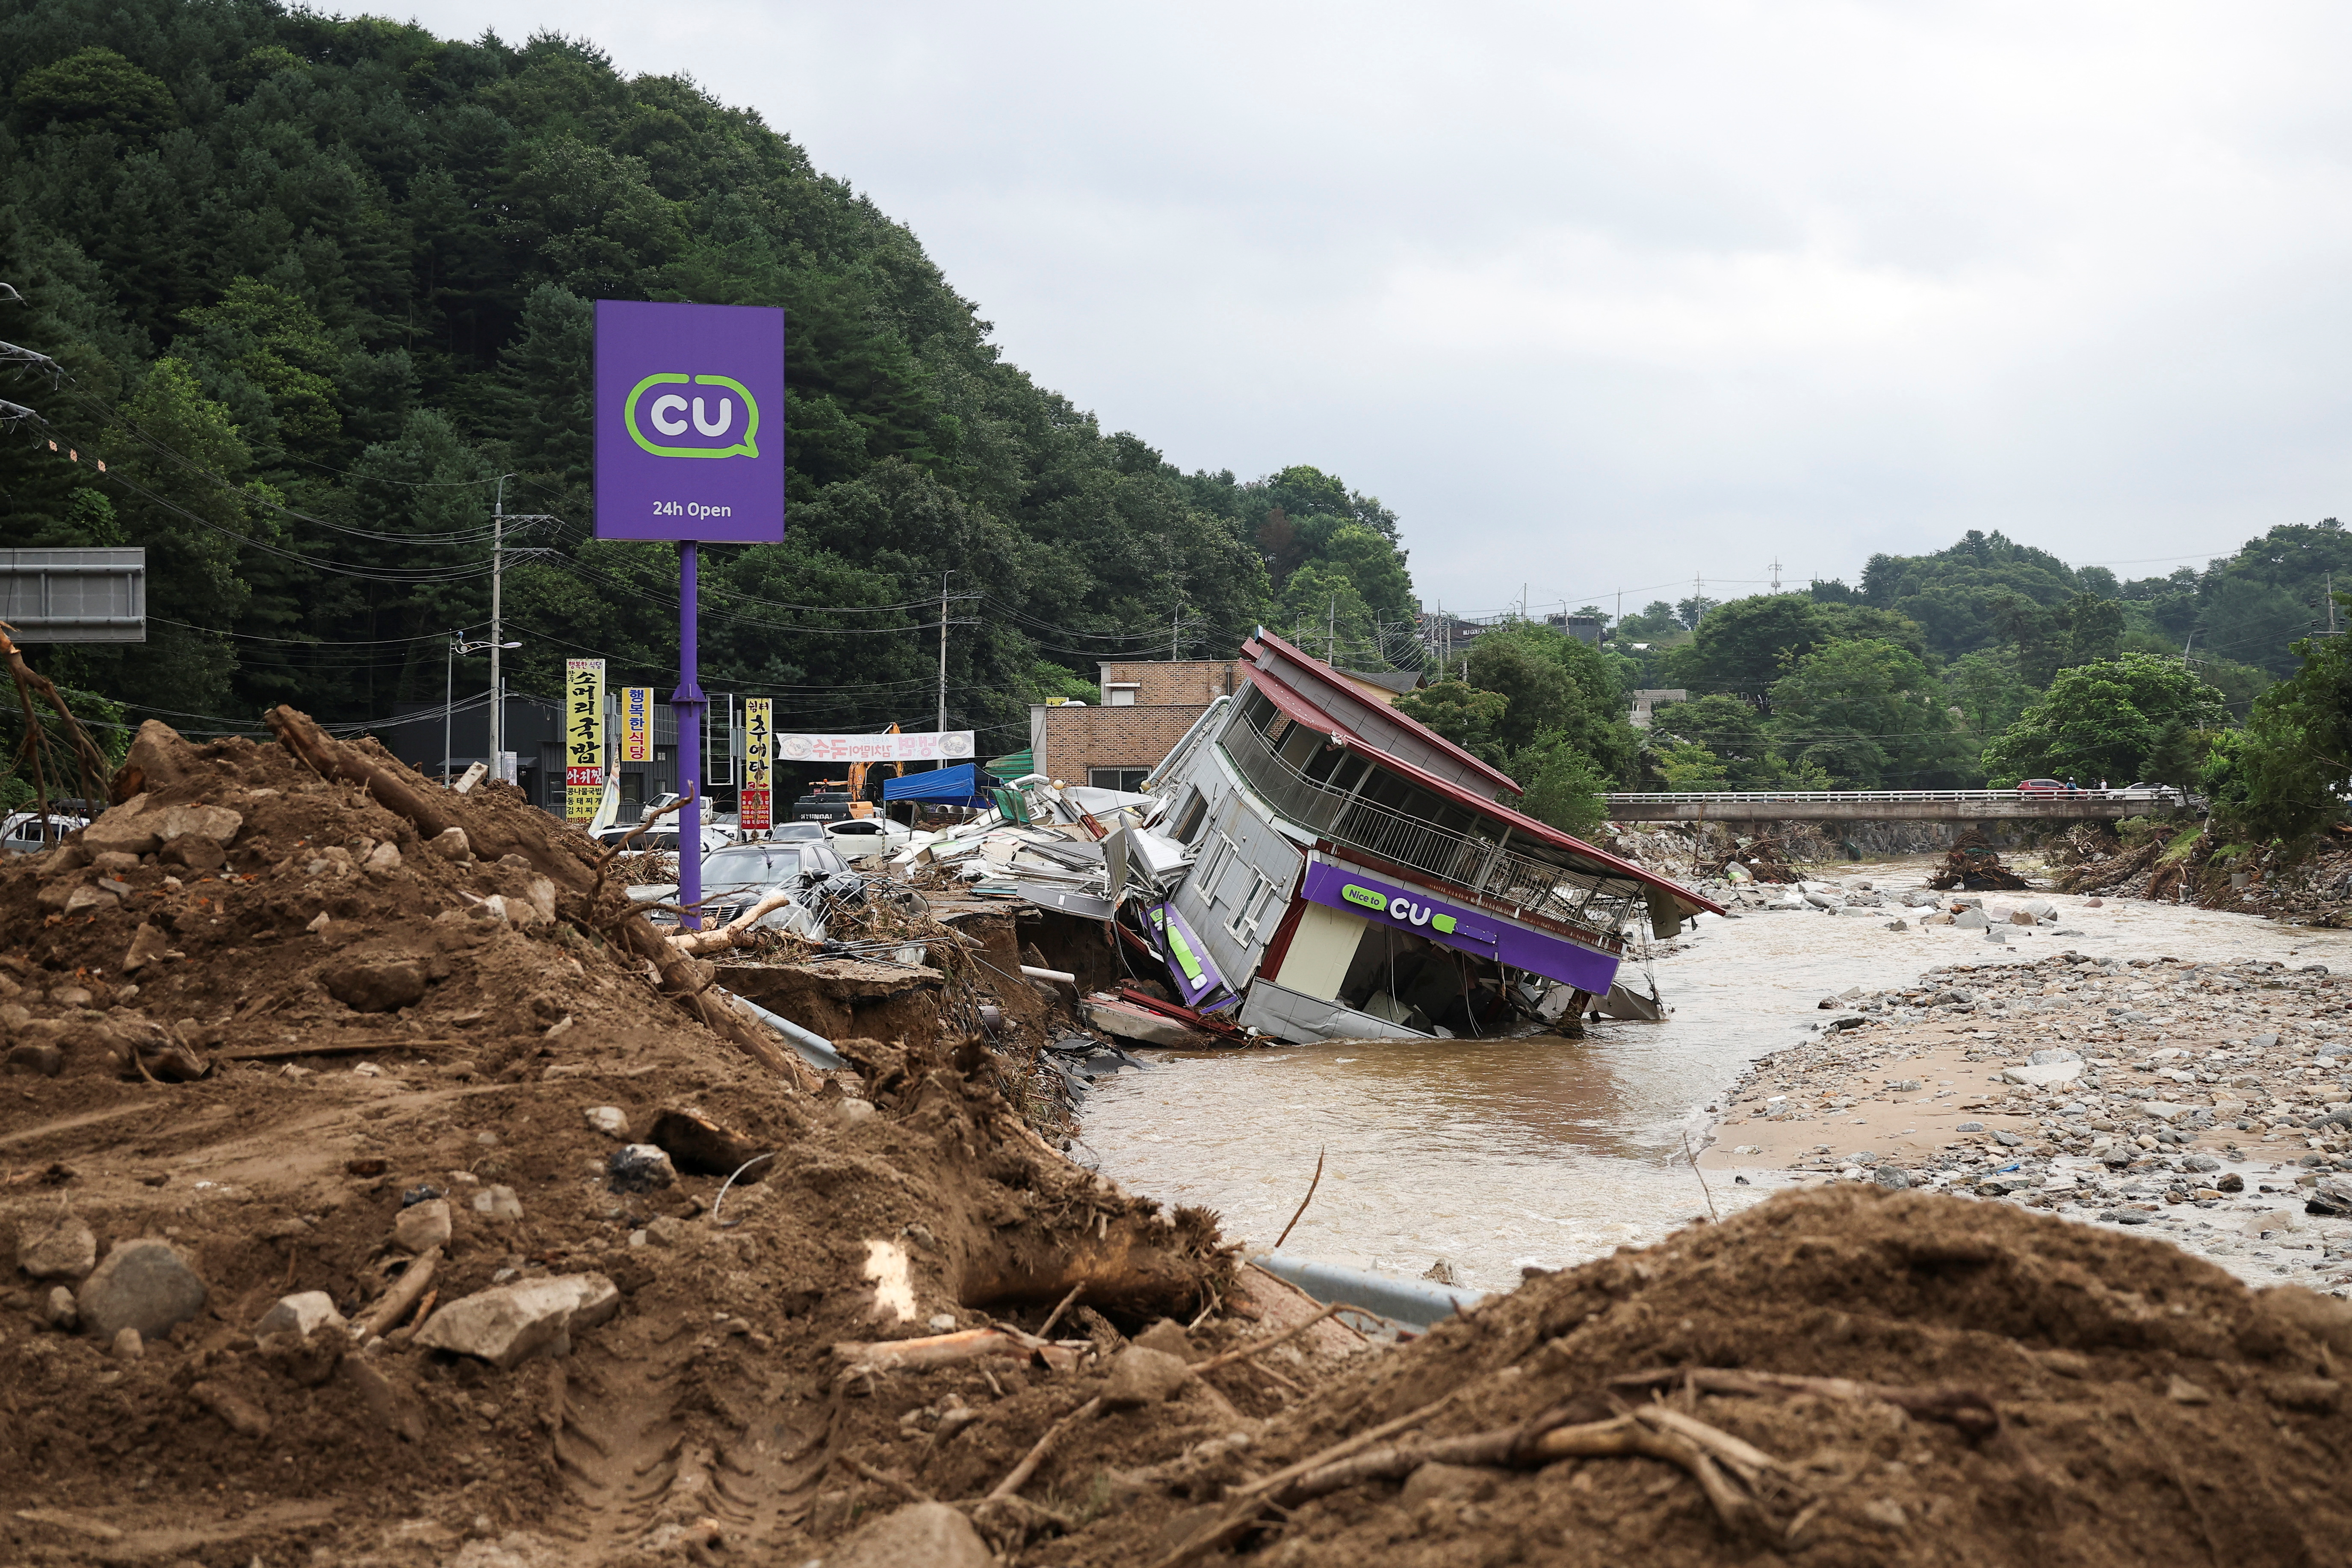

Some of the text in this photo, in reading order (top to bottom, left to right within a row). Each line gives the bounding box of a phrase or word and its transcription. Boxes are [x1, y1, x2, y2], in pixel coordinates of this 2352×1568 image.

[651, 394, 732, 437] CU
[653, 501, 731, 520] 24h Open
[567, 670, 575, 682] 한우
[568, 661, 588, 669] 행복한
[569, 671, 601, 764] 소머리국밥
[748, 701, 769, 712] 쉼터
[749, 715, 769, 781] 추어탕
[1349, 889, 1431, 926] Nice to CU
